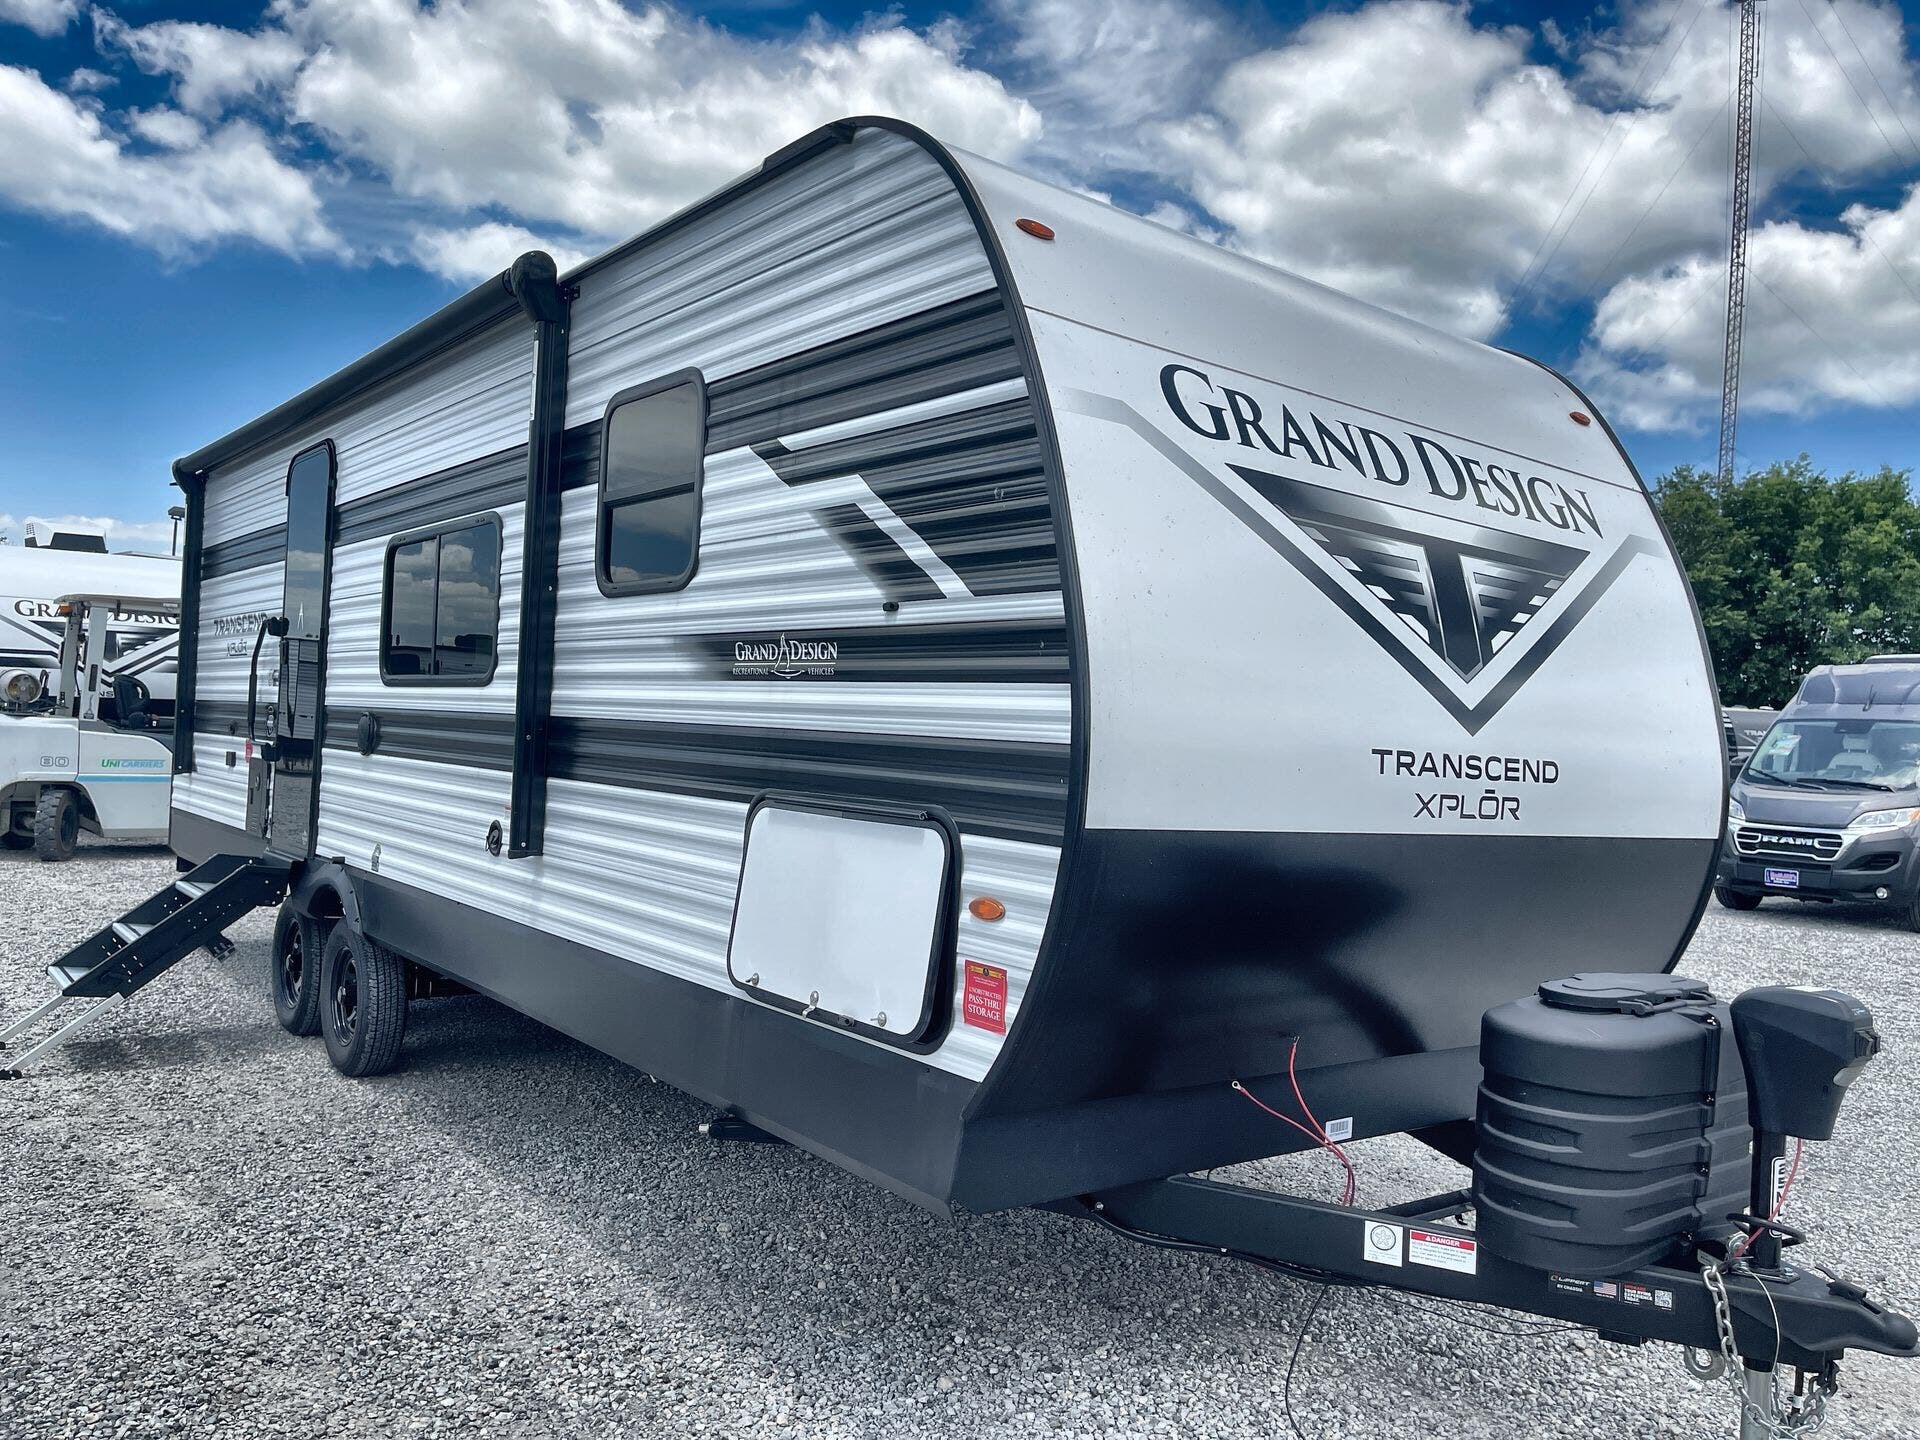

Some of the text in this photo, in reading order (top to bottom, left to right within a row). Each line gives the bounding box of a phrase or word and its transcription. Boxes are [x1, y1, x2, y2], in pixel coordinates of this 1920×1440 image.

[1159, 363, 1603, 540] GRAND DESIGN
[735, 640, 838, 660] GRAND DESIGN
[1371, 748, 1560, 784] TRANSCEND
[1762, 834, 1813, 846] RAM
[968, 993, 1002, 1010] PASS-THRU
[967, 1004, 1001, 1021] STORAGE
[1431, 1236, 1460, 1247] DANGER
